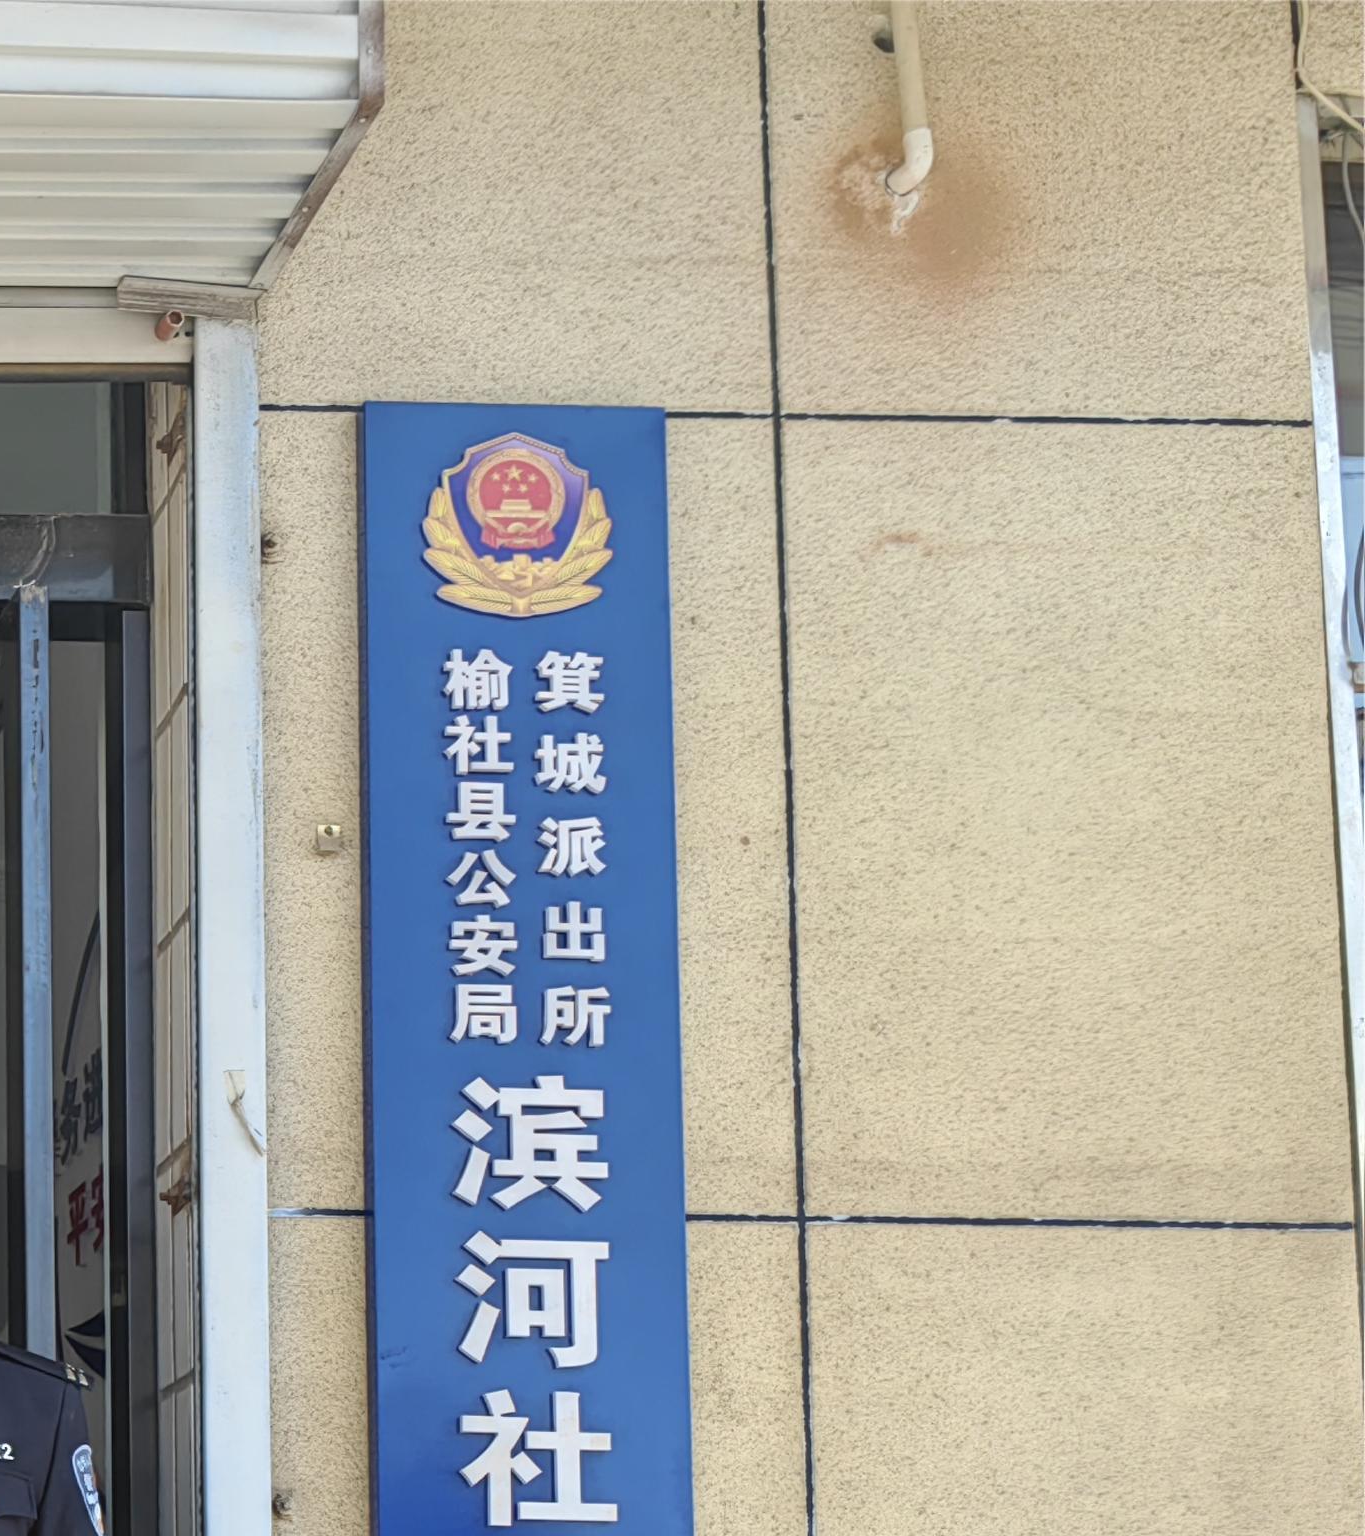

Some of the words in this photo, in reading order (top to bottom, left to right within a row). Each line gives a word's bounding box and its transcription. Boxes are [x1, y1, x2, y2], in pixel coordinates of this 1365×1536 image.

[443, 649, 517, 1045] 榆社县公安局
[535, 650, 611, 1047] 箕城派出所
